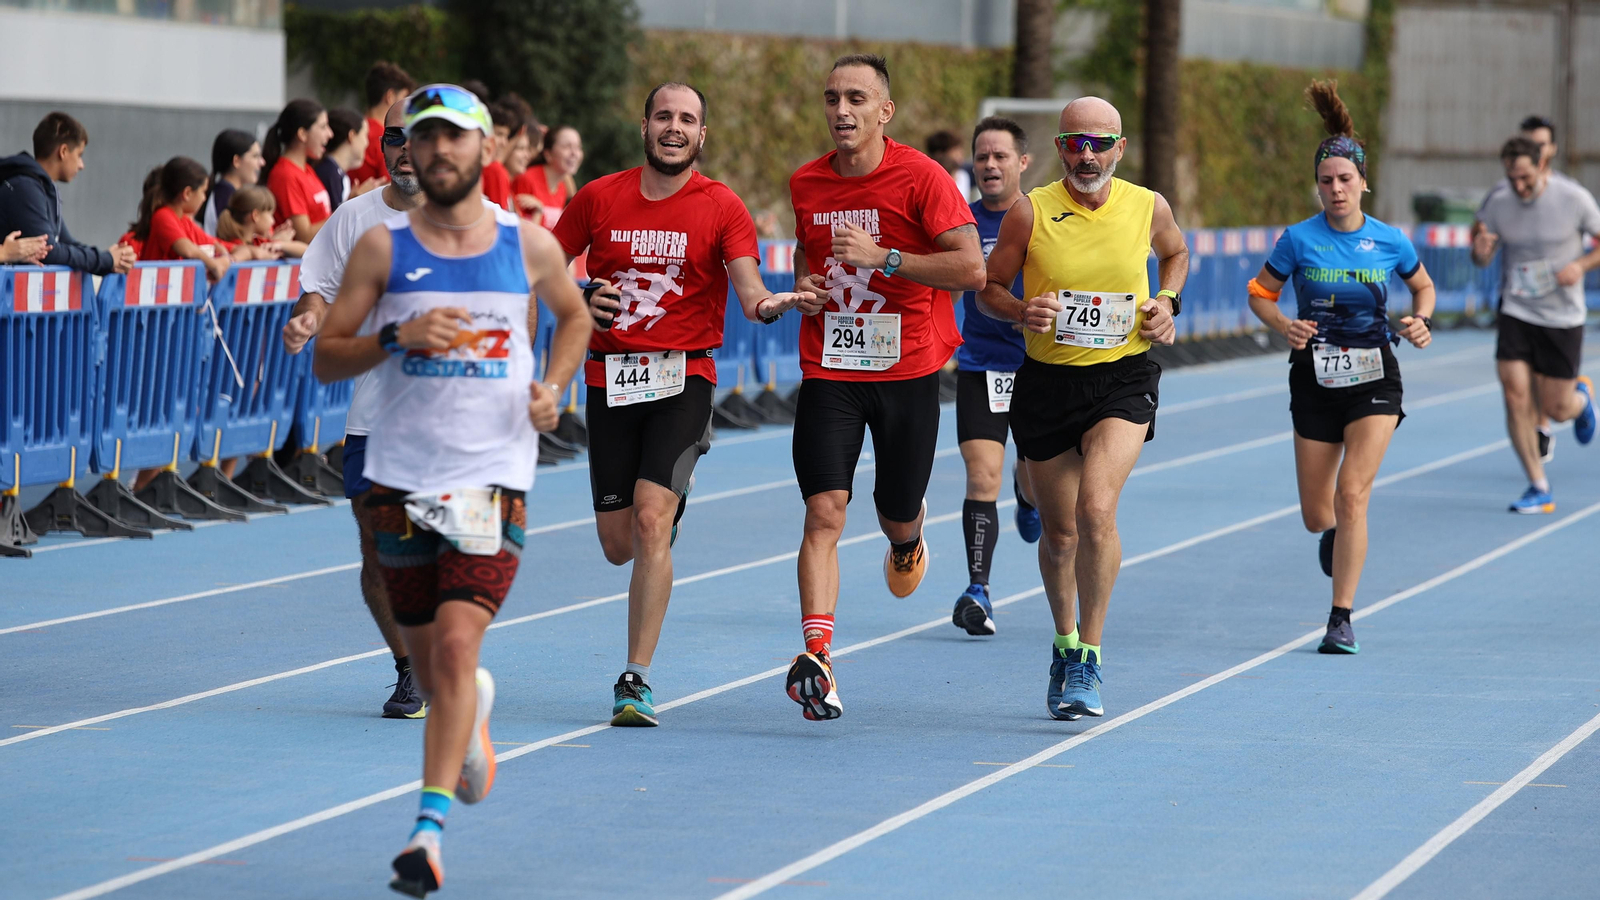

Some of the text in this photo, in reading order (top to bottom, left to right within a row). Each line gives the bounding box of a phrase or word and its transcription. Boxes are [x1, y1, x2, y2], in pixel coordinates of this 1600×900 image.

[813, 208, 880, 225] XLII CARRERA
[610, 229, 688, 246] XLII CARRERA
[630, 242, 686, 258] POPULAR
[658, 257, 666, 265] DE
[1304, 266, 1350, 283] CORIPE
[1066, 306, 1101, 327] 749
[832, 328, 866, 349] 294
[1321, 354, 1352, 372] 773
[615, 367, 651, 387] 444
[995, 377, 1014, 394] 82
[970, 512, 992, 572] kalenji
